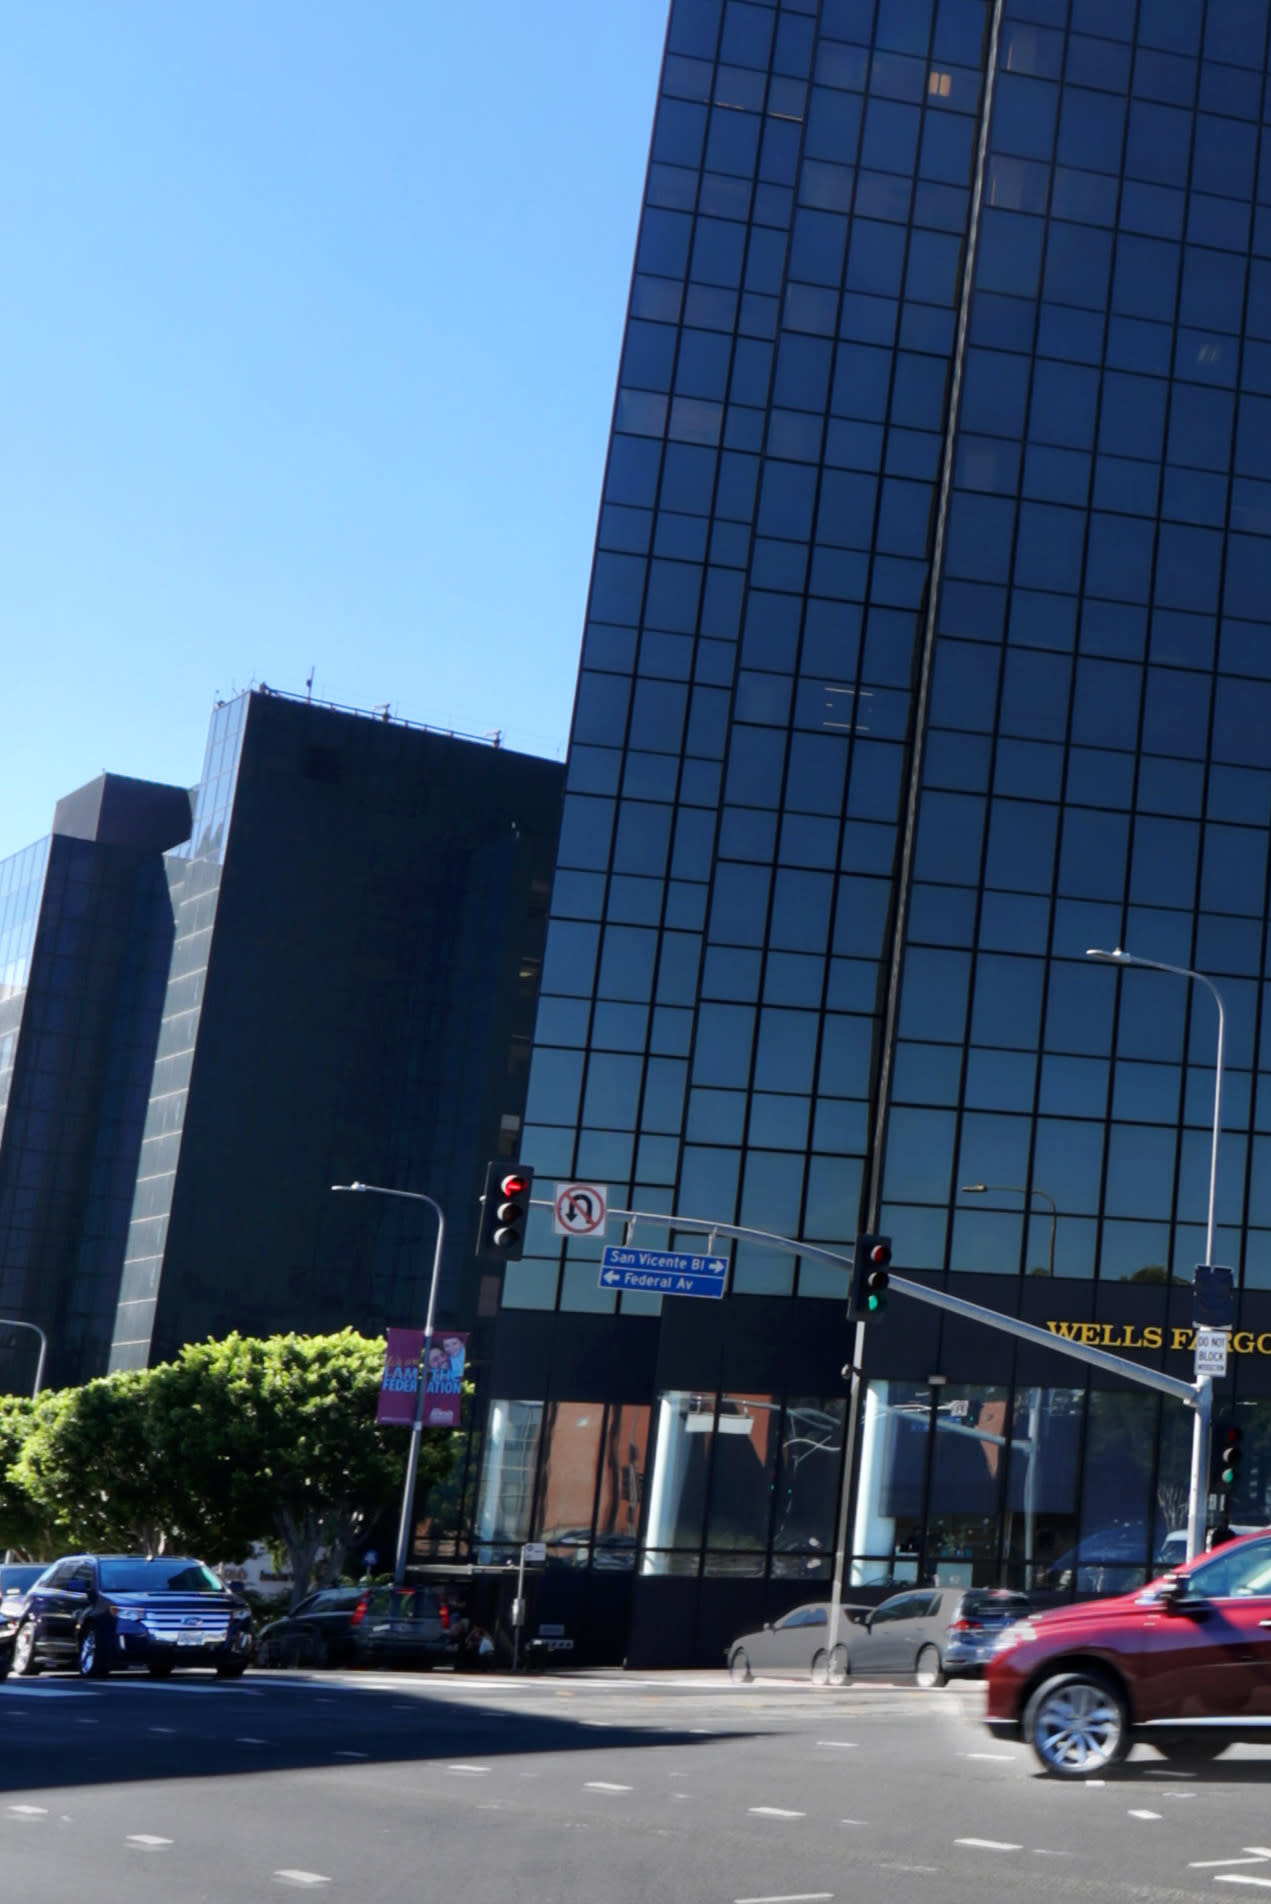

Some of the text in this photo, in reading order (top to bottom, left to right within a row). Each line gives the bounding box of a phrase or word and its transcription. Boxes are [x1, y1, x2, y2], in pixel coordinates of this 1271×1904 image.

[610, 1250, 705, 1270] San Vicente Bl
[624, 1272, 694, 1289] Federal Av
[1047, 1321, 1162, 1348] WELLS
[1199, 1336, 1225, 1347] DO NOT
[1198, 1350, 1225, 1361] BLOCK
